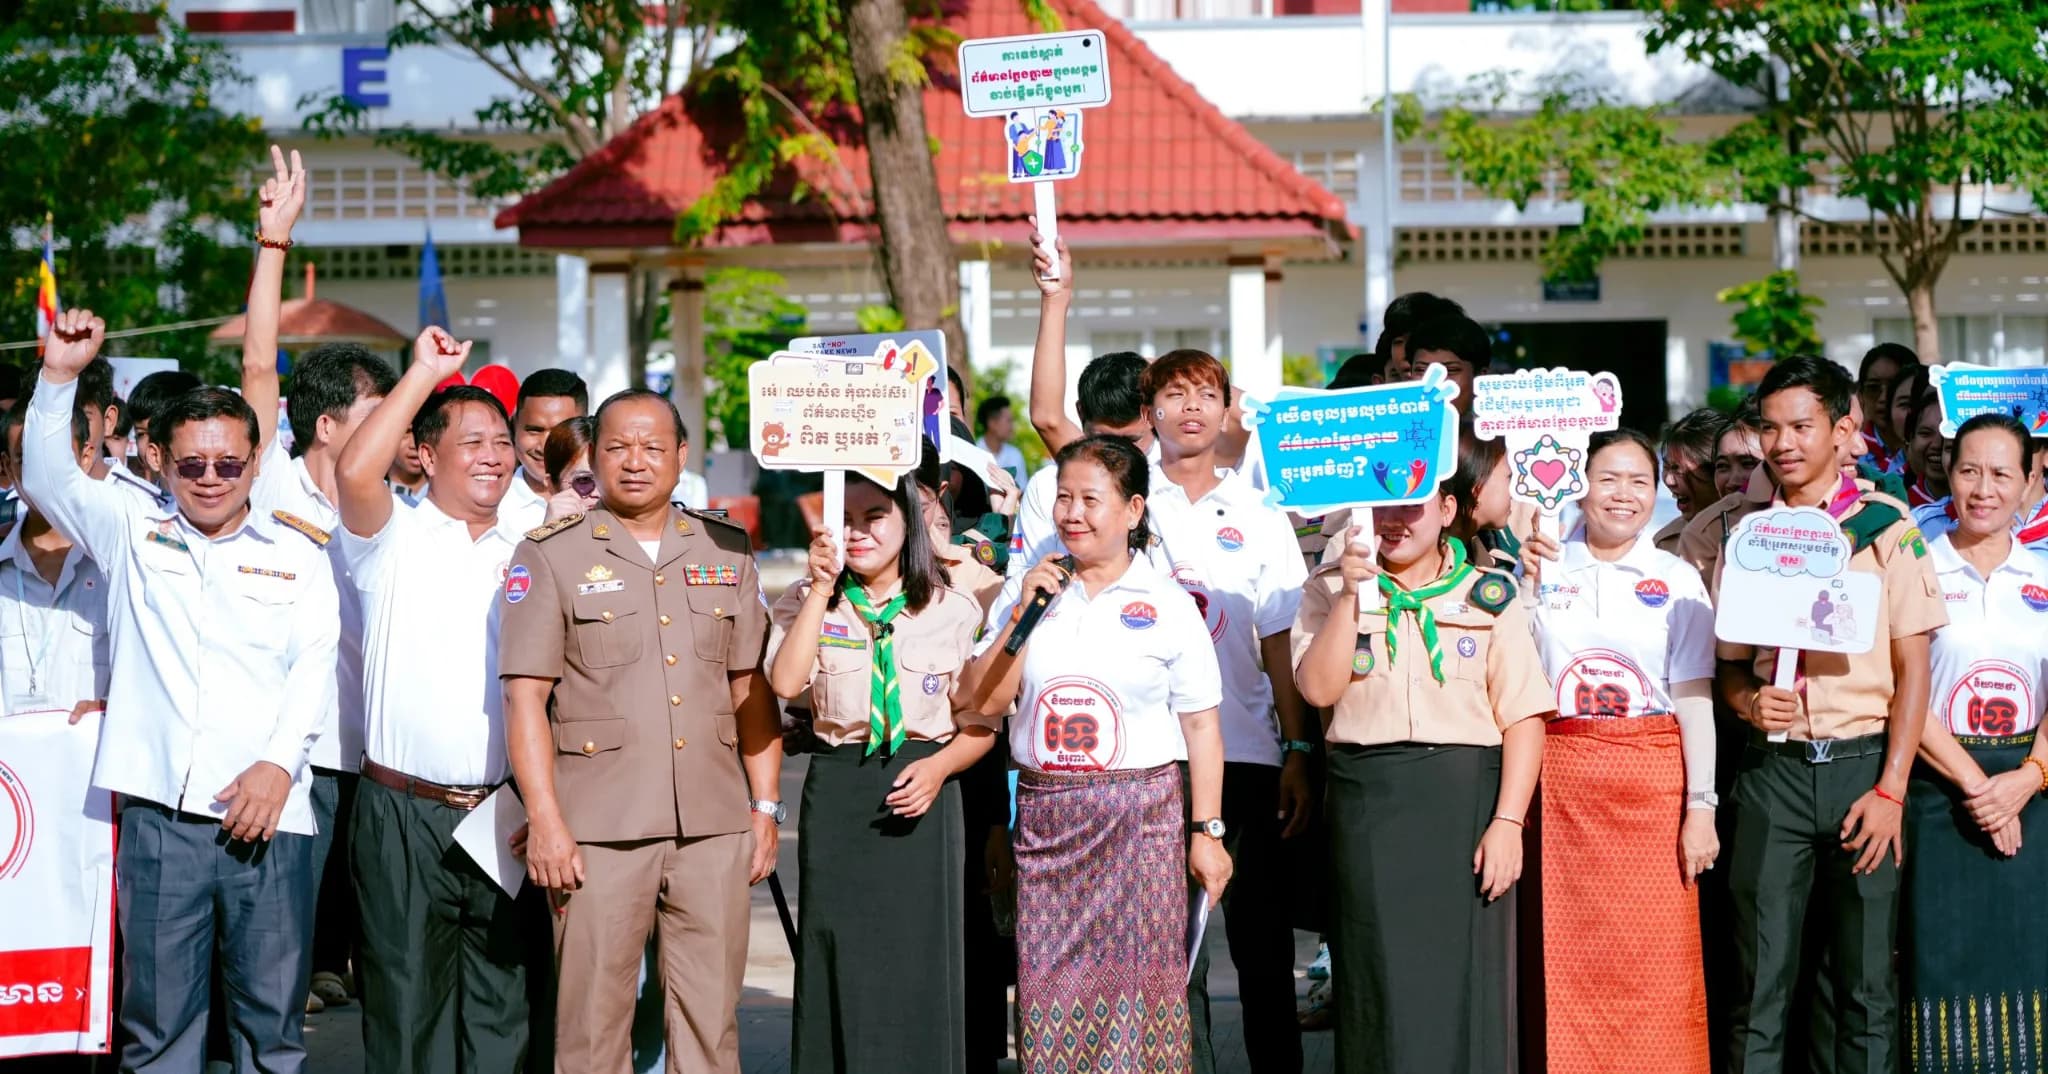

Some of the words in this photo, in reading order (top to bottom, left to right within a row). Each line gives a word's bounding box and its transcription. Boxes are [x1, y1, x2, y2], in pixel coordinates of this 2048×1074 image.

[342, 47, 390, 106] E
[786, 382, 840, 398] ឈប់សិន
[800, 425, 829, 445] ពិត
[1281, 456, 1368, 483] ចុះអ្នកវិញ?
[1044, 712, 1100, 752] ទេ
